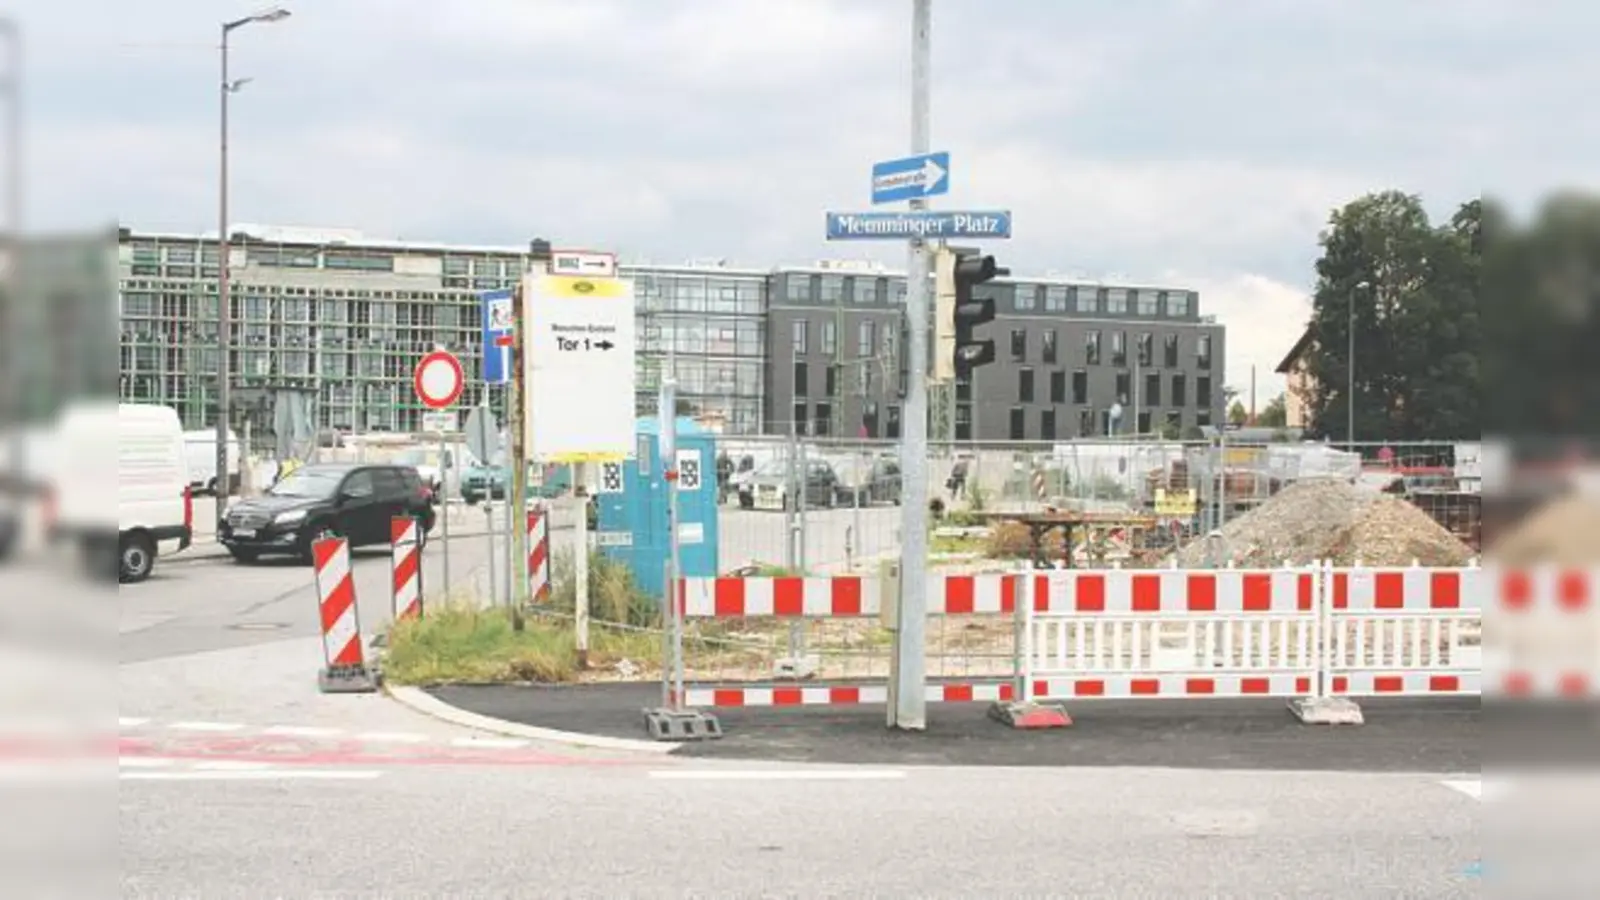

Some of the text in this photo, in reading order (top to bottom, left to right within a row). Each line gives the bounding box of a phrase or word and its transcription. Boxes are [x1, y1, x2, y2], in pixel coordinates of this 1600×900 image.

[838, 214, 999, 235] Memminger Platz
[556, 336, 590, 351] Tor 1
